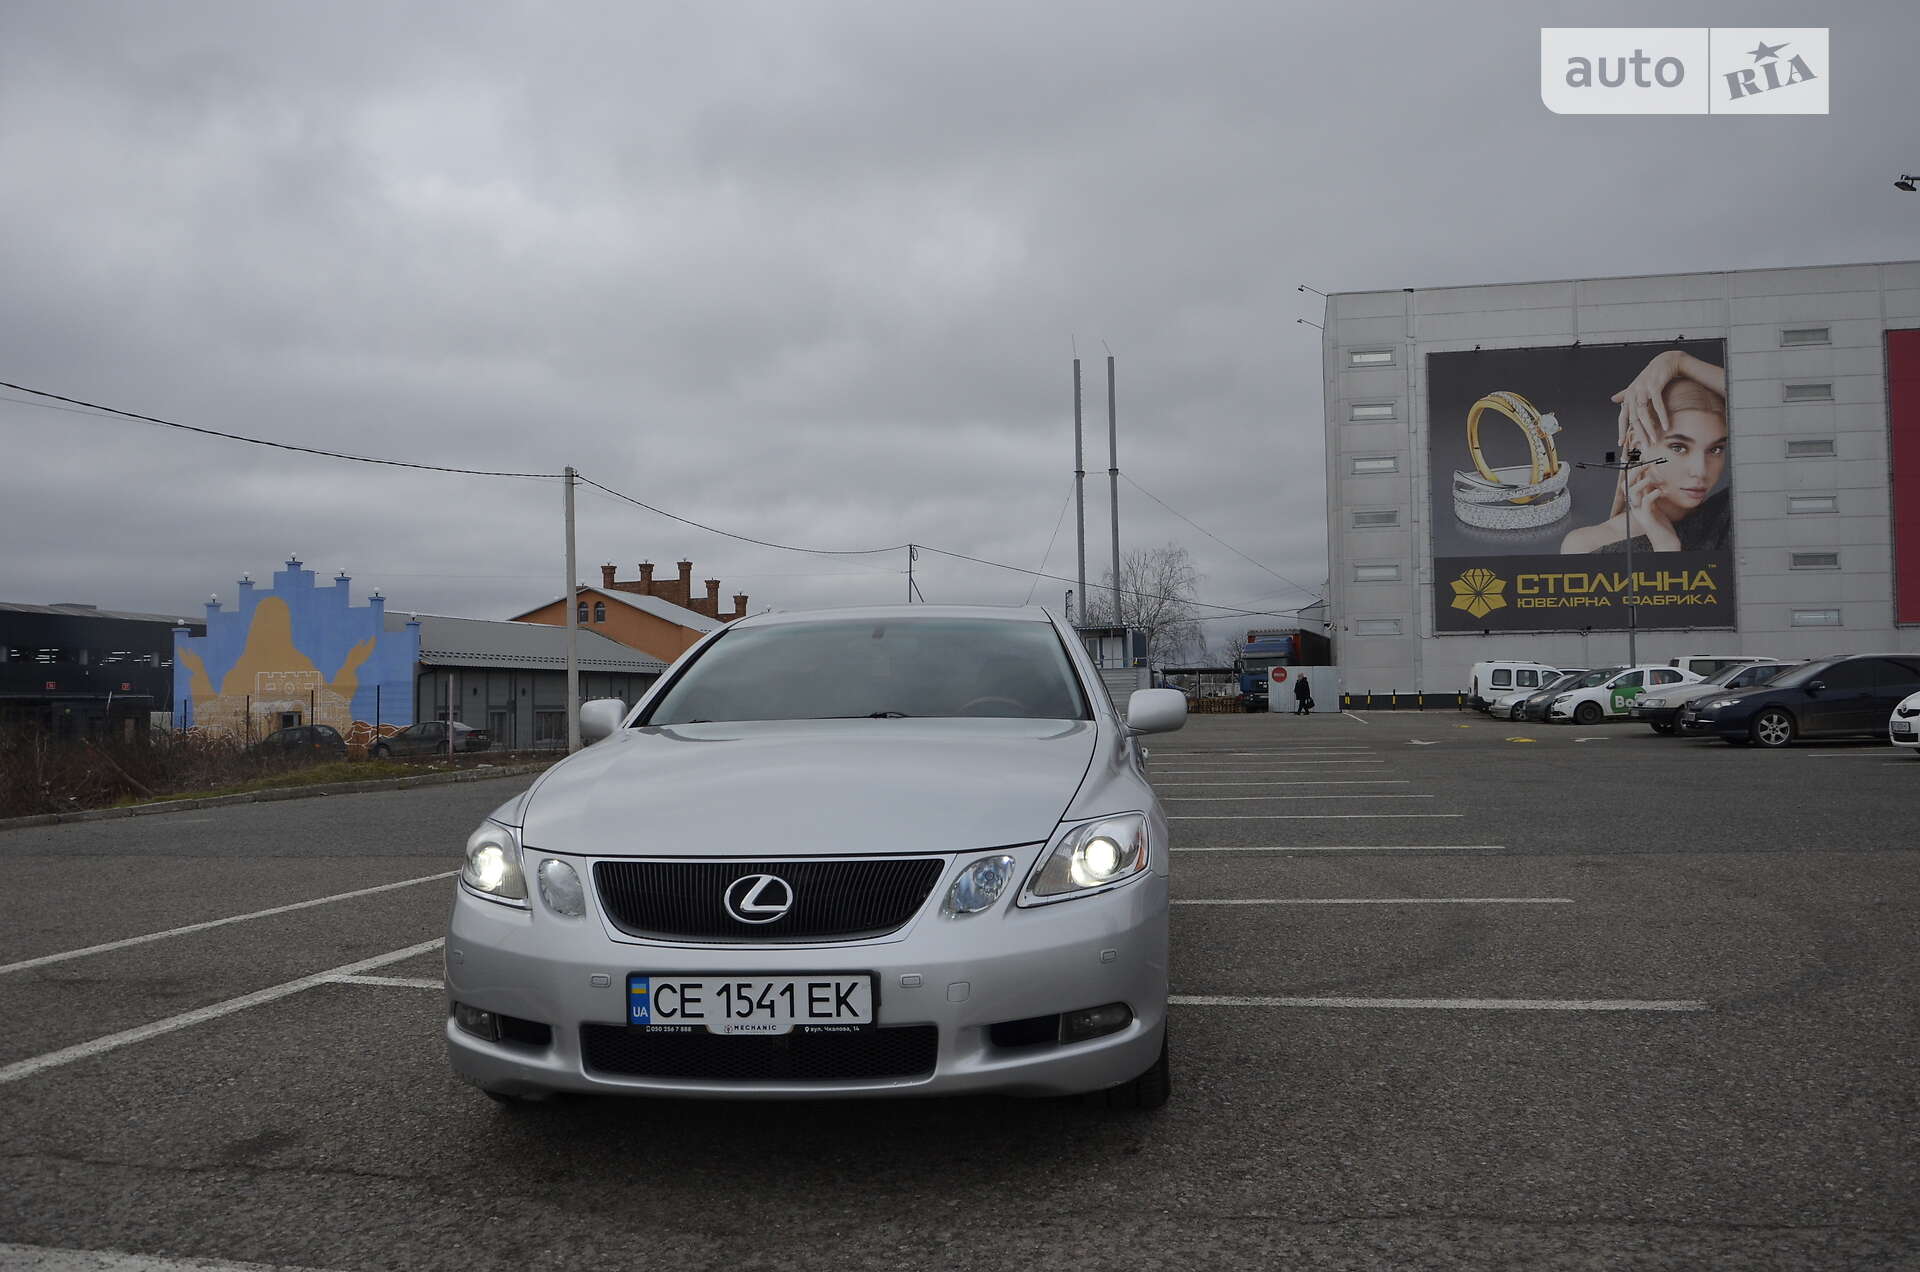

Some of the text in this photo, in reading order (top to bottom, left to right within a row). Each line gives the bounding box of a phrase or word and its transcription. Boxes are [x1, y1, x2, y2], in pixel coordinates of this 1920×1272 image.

[1516, 570, 1718, 595] СТОЛИЧНА
[1517, 596, 1612, 609] ЮВЕЛІРНА
[633, 982, 860, 1019] UA CE 1541 EK
[734, 1024, 777, 1032] MECHANIC
